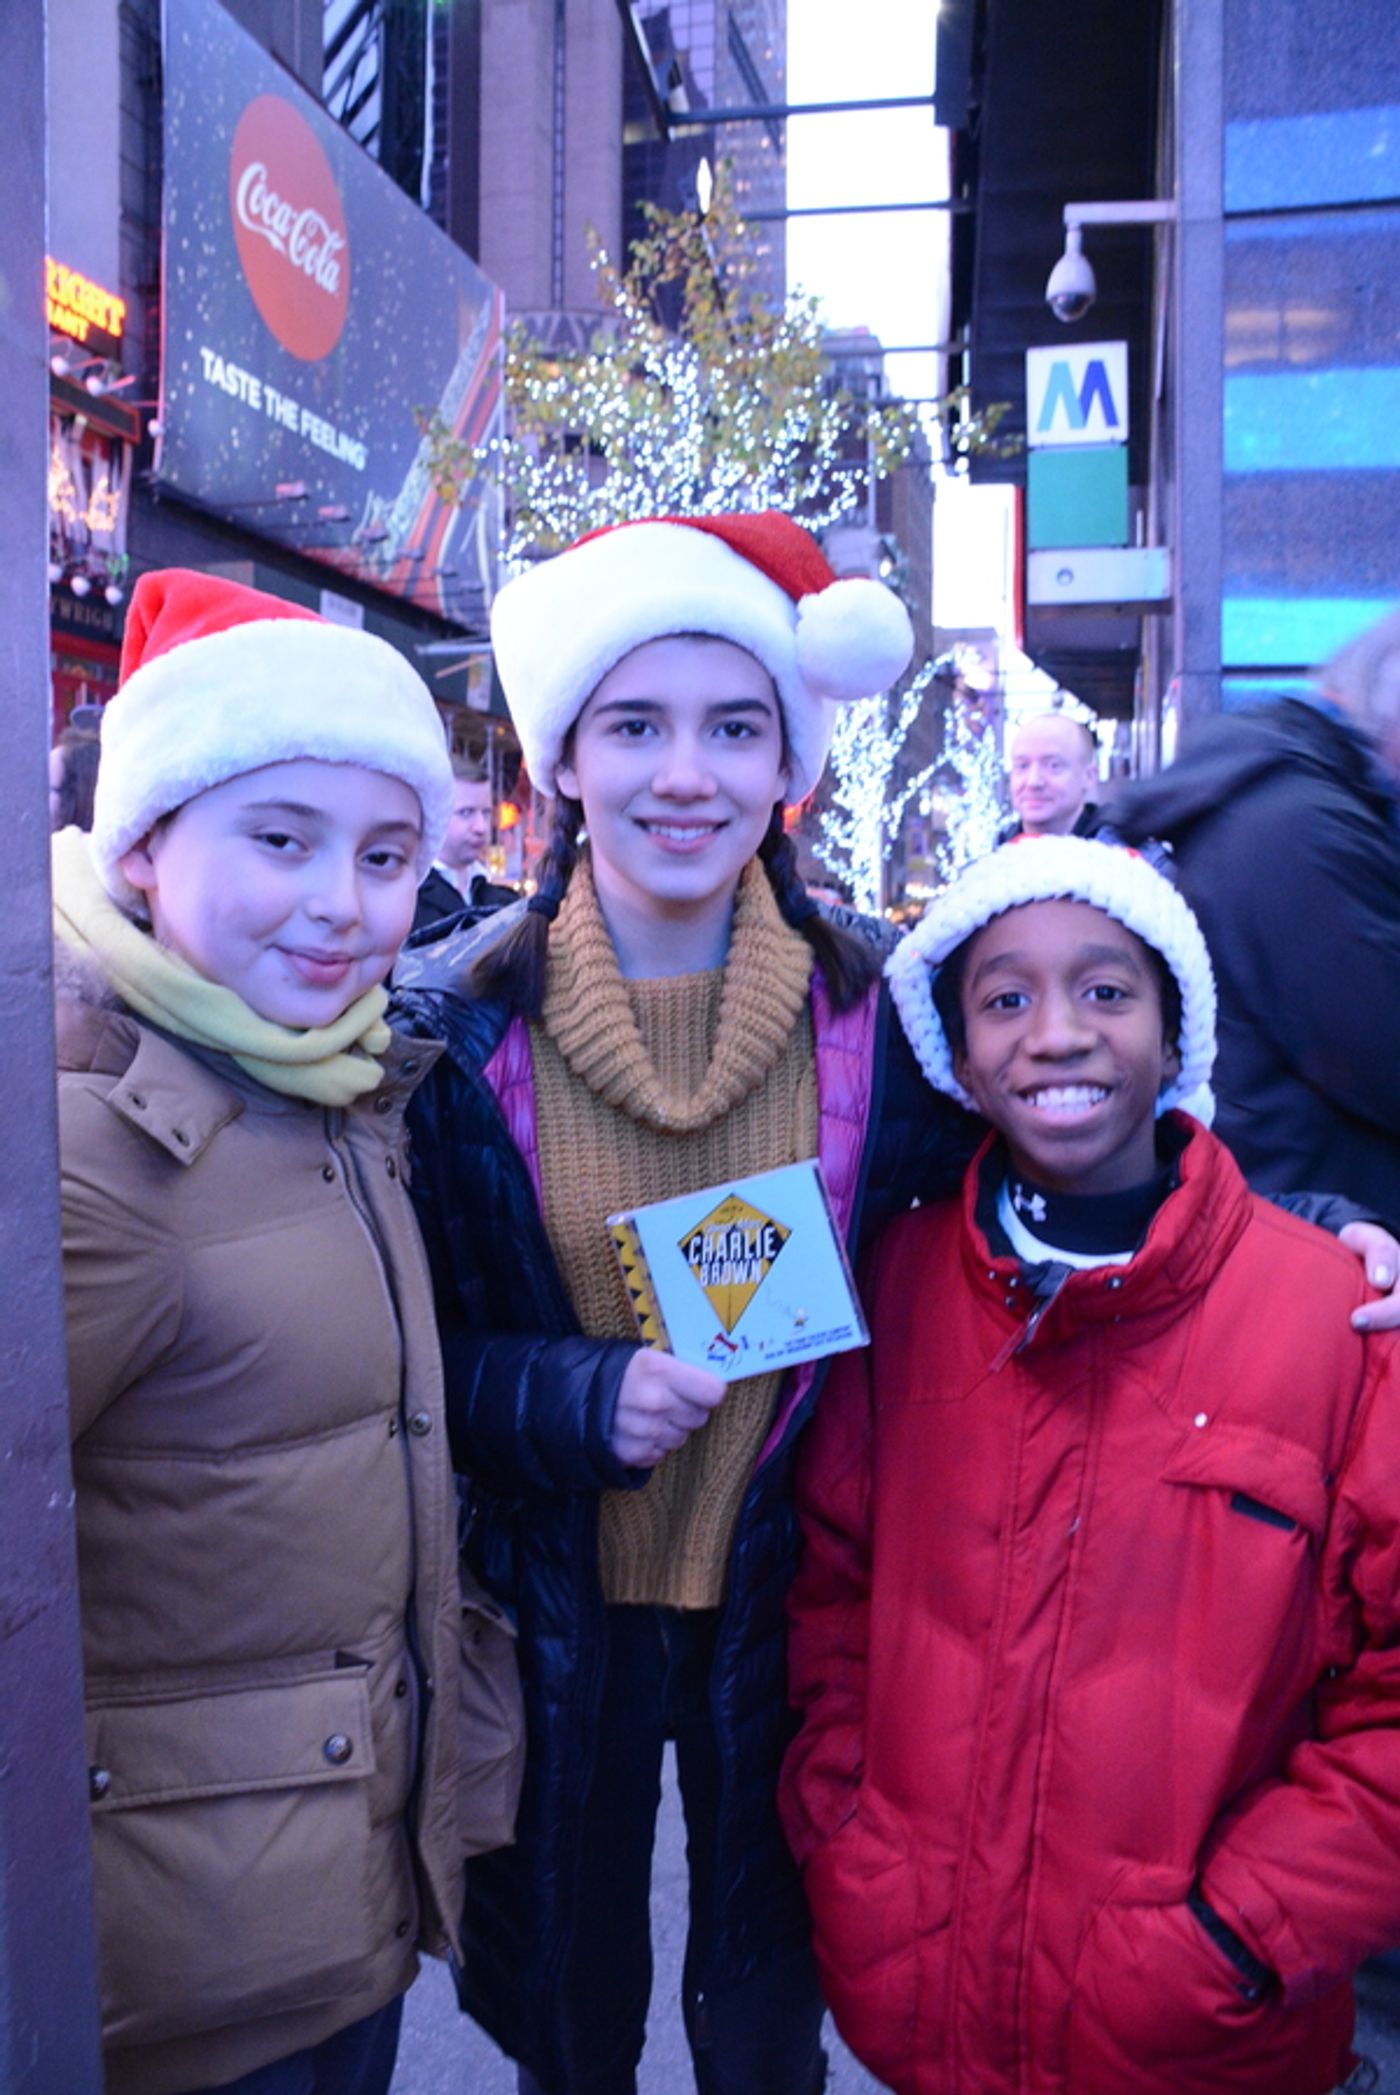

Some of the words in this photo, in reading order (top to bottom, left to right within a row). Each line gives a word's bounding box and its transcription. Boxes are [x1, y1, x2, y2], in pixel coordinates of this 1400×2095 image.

[236, 161, 346, 294] Coca-Cola
[200, 346, 262, 411] TASTE
[263, 384, 299, 433] THE
[301, 408, 369, 471] FEELING
[688, 1226, 778, 1266] CHARLIE
[700, 1258, 762, 1287] BROWN
